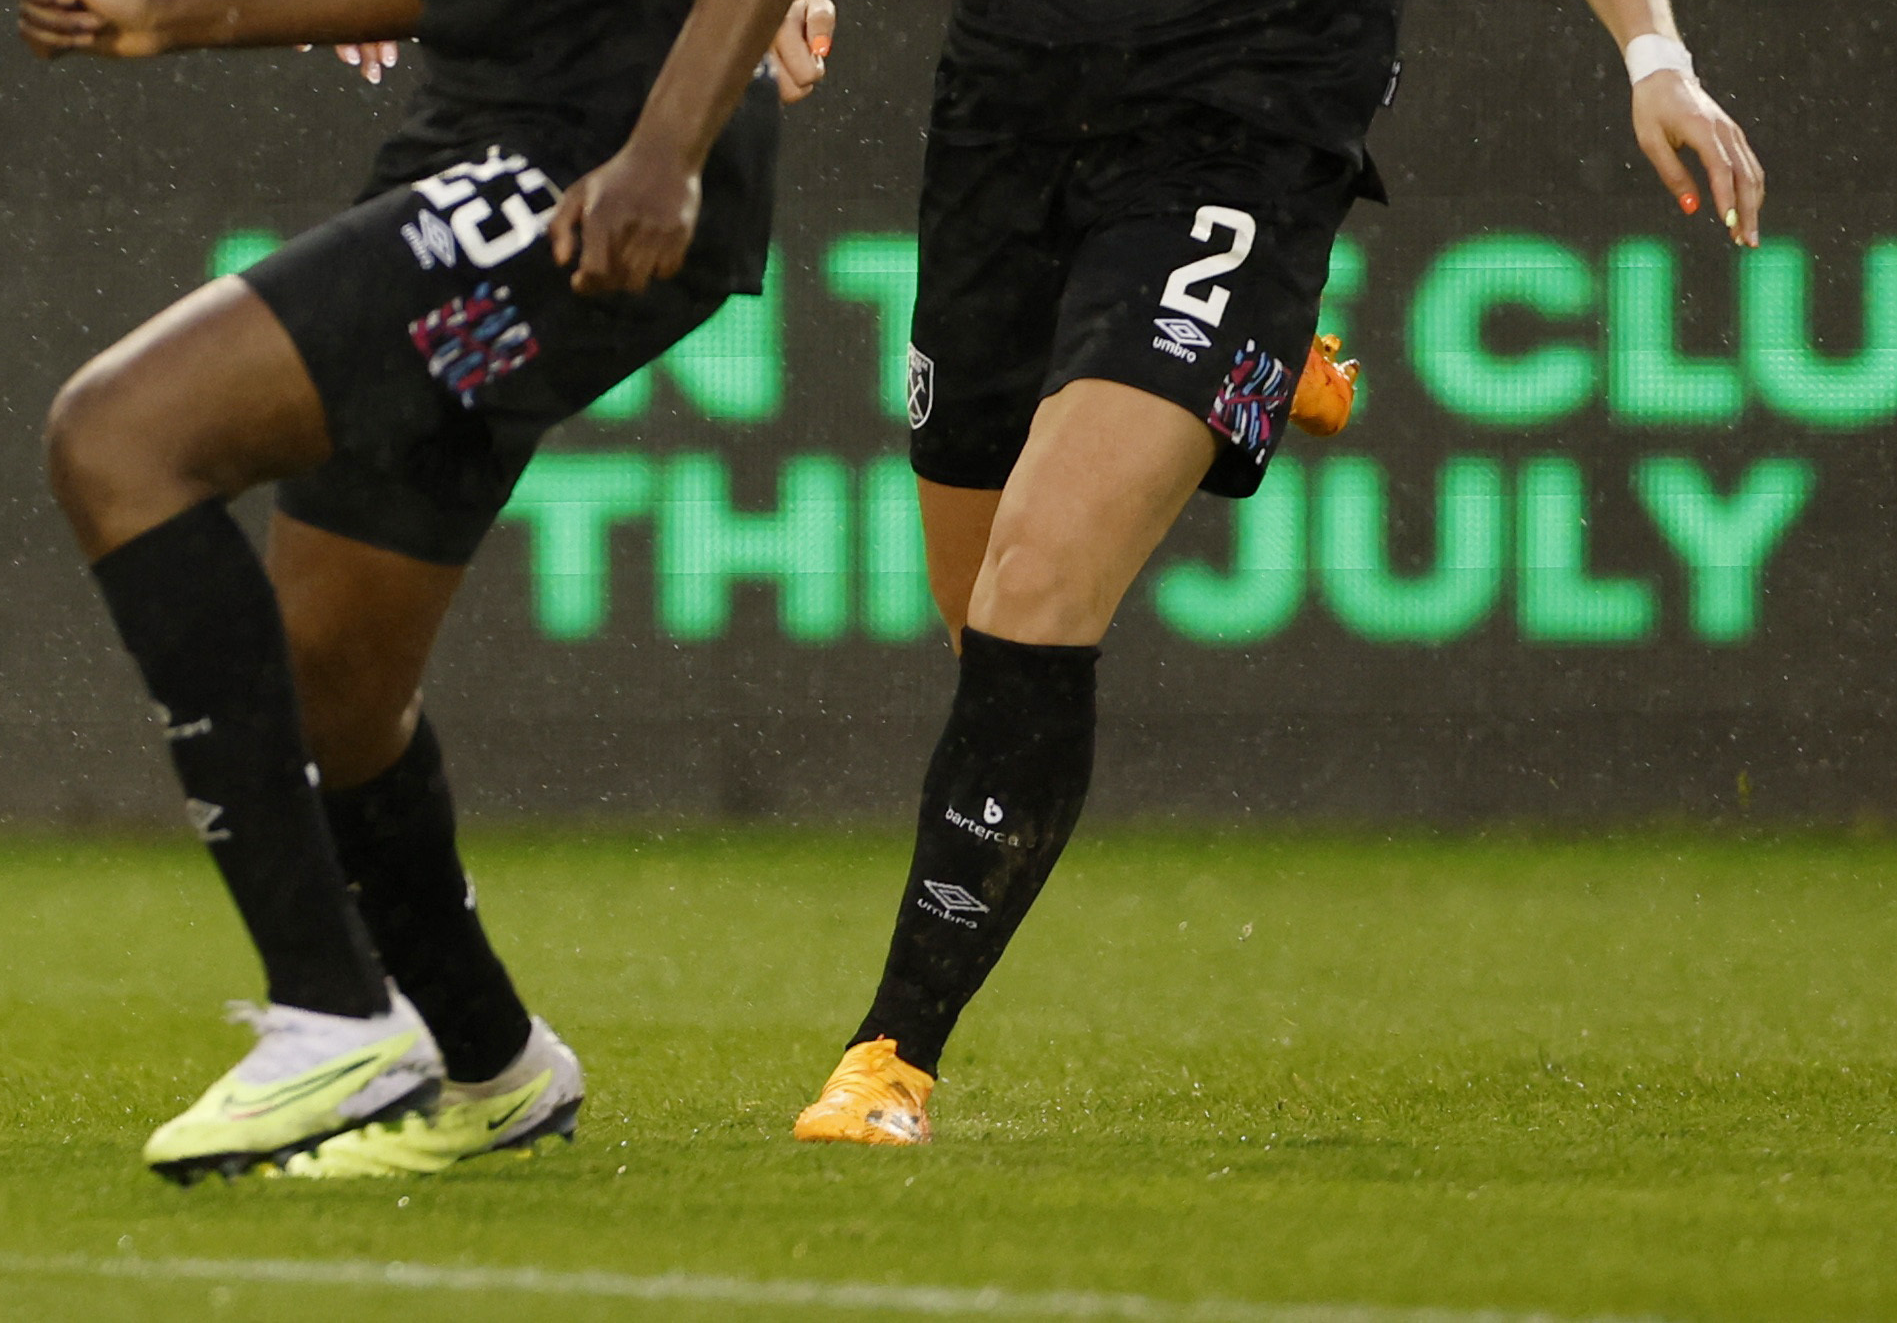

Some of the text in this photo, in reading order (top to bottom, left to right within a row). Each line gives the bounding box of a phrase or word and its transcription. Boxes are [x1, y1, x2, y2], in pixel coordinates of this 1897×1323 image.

[1160, 205, 1256, 328] 2
[1153, 335, 1197, 364] umbro
[500, 452, 936, 643] THI
[1154, 454, 1816, 644] JULY
